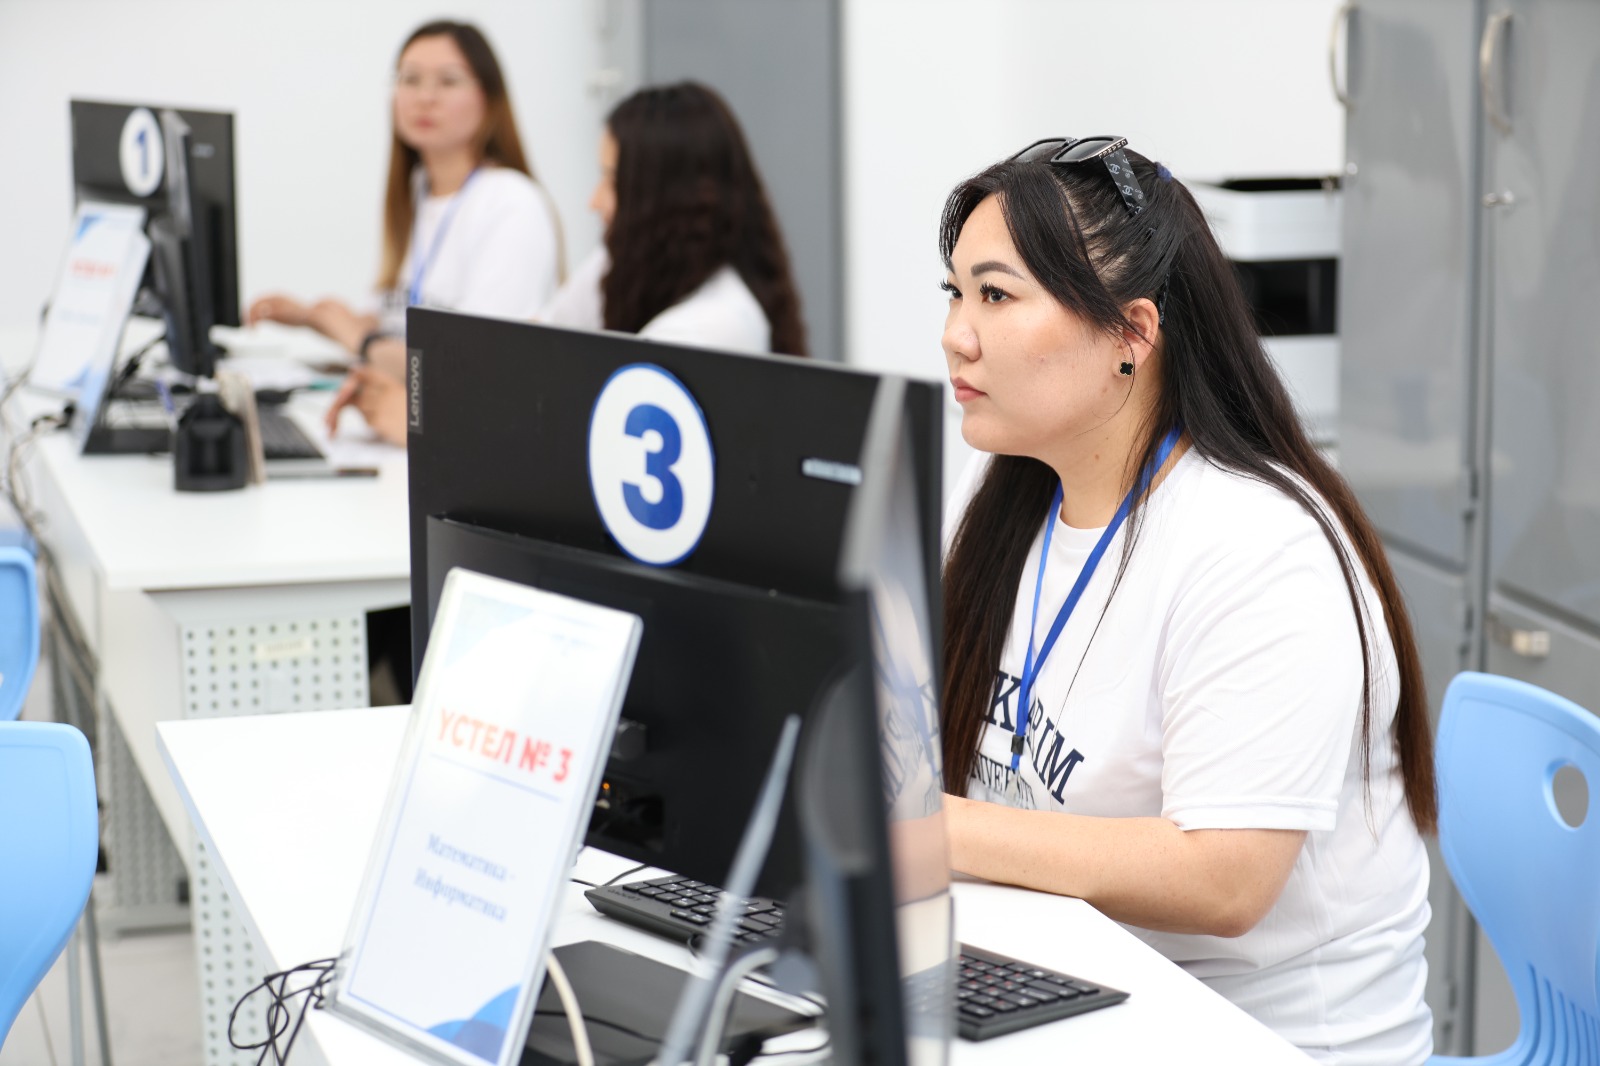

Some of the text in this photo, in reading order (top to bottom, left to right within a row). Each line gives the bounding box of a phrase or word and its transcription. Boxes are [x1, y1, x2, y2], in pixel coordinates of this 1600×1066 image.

[133, 127, 149, 178] 1
[410, 355, 420, 427] Lenovo
[622, 403, 684, 531] 3
[518, 736, 552, 772] №
[553, 748, 573, 783] 3
[427, 832, 508, 881] Математика
[413, 866, 508, 923] Информатика
